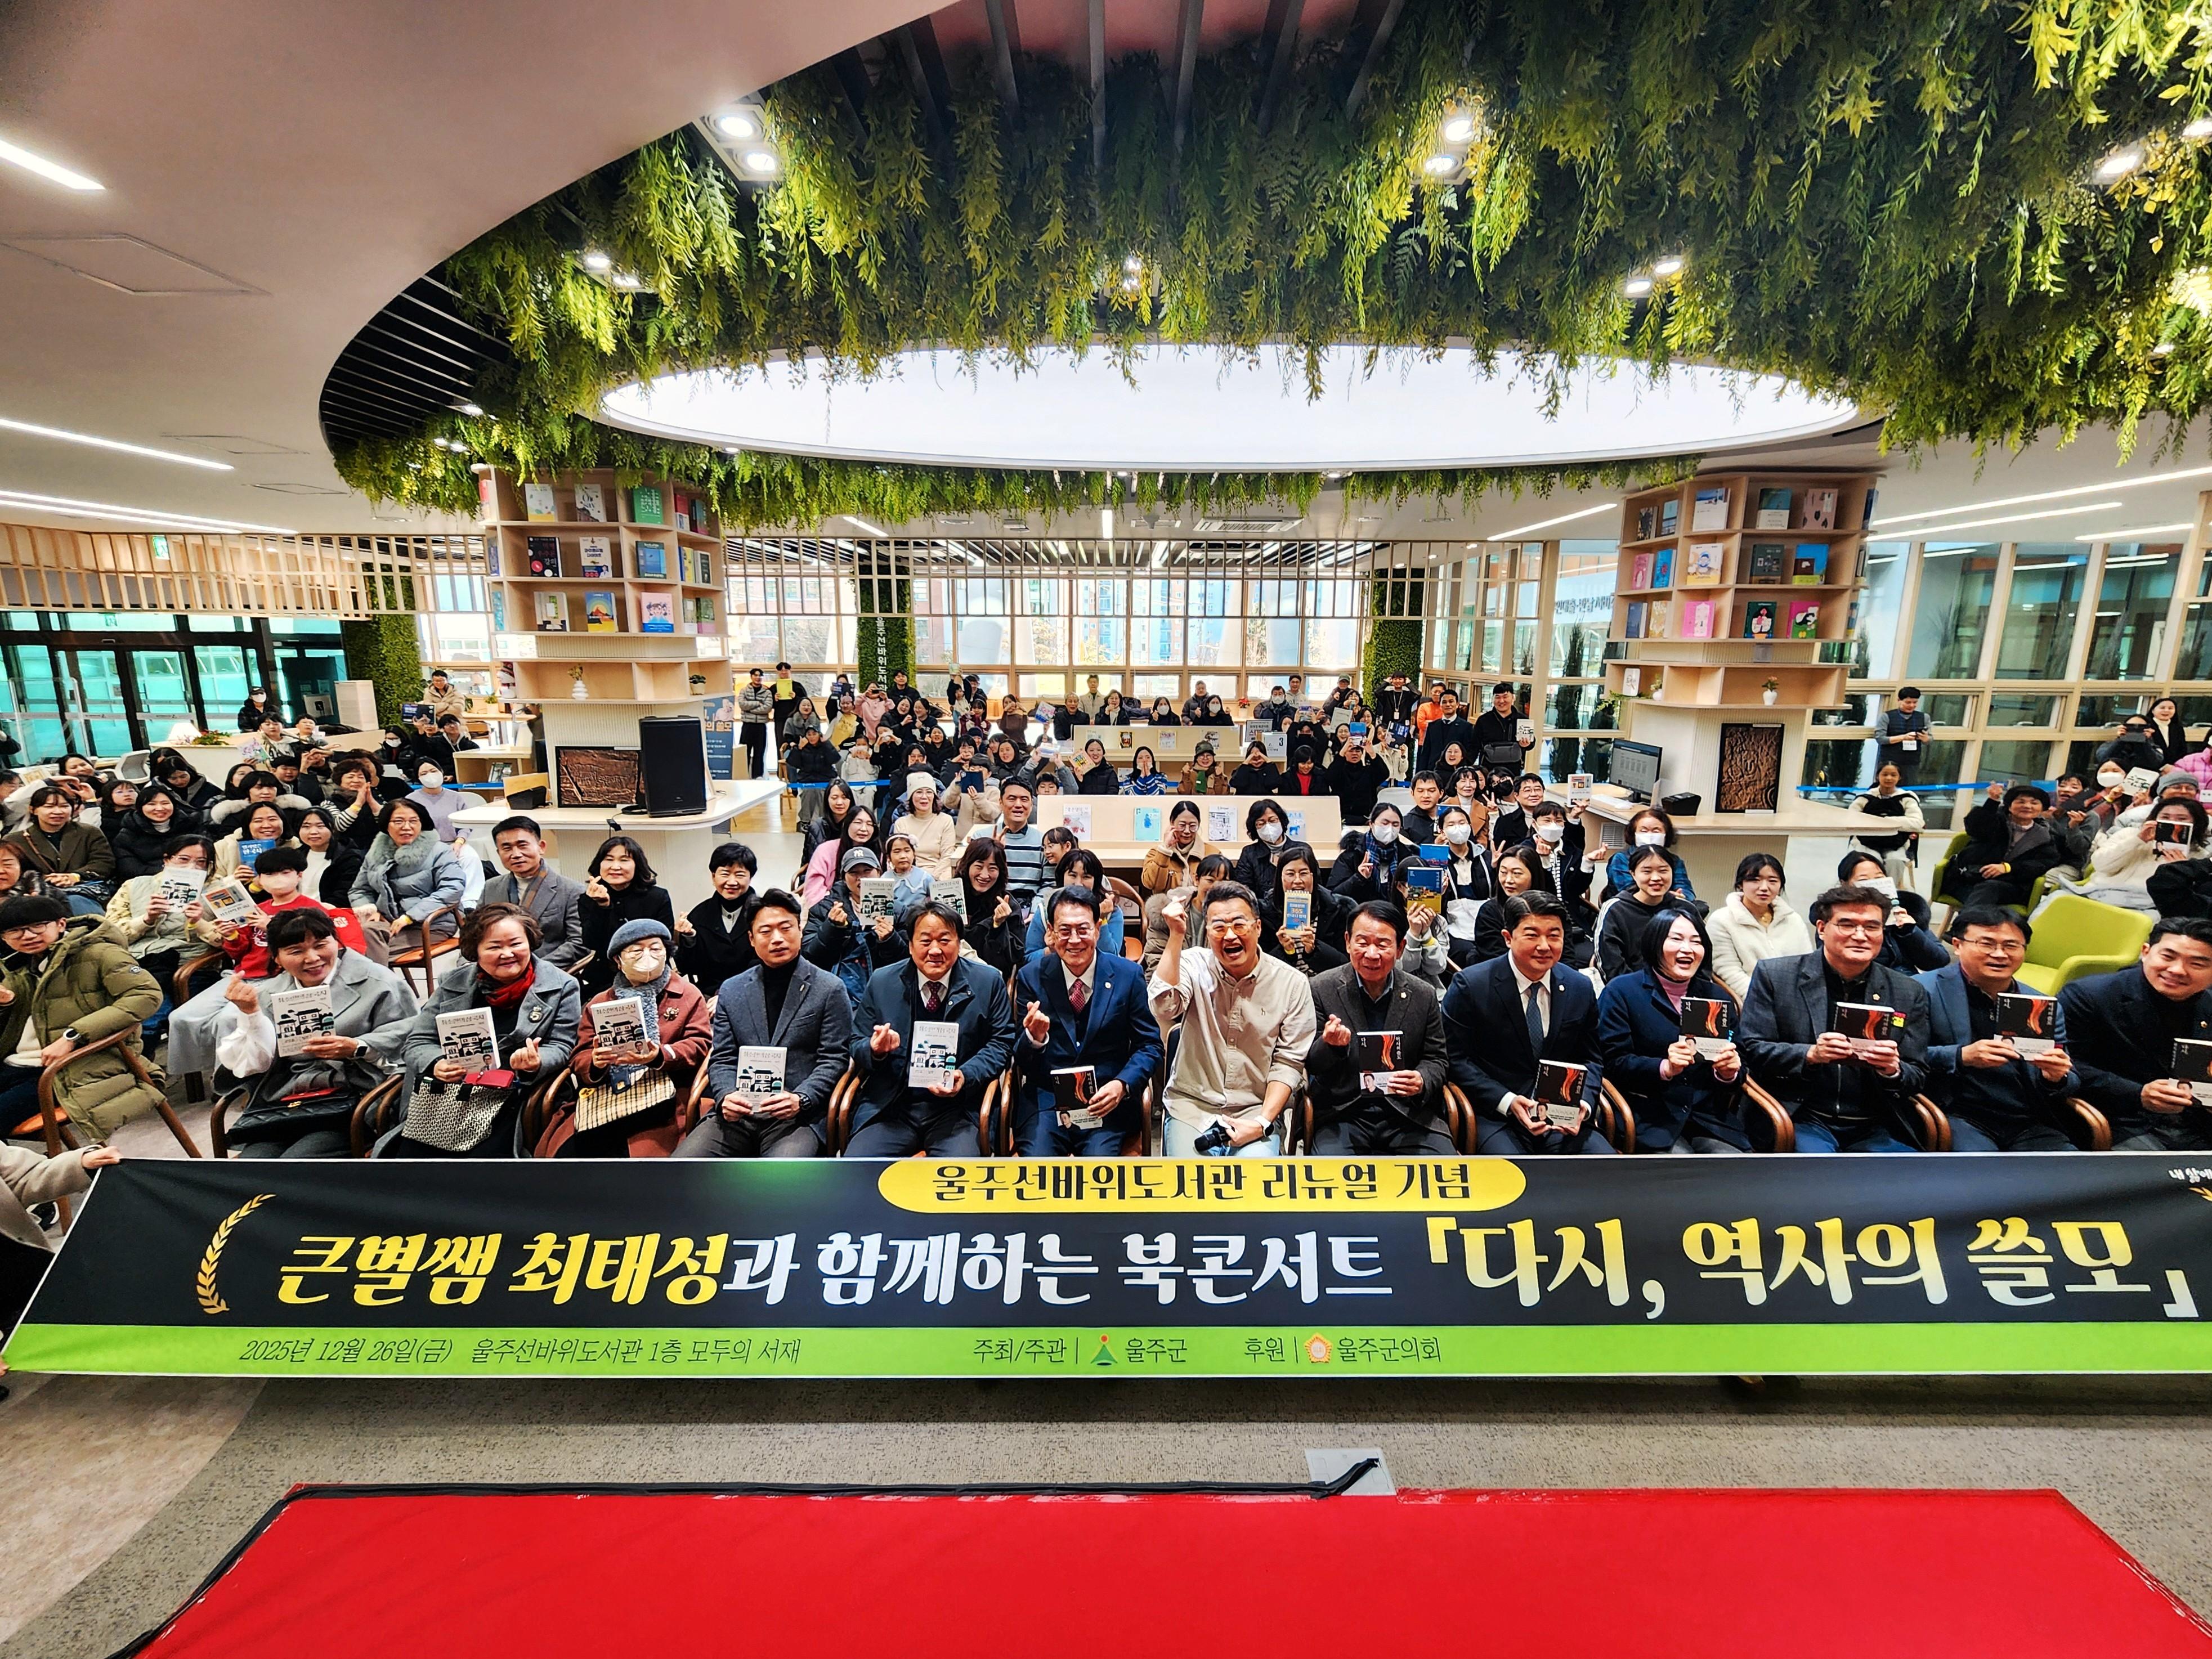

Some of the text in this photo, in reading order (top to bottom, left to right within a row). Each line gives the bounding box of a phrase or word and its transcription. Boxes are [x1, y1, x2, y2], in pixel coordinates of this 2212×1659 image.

[1555, 595, 1614, 615] 인대출·반납 서비
[717, 721, 732, 731] 쓸모
[1279, 737, 1284, 746] 3
[853, 849, 864, 858] NY
[932, 1164, 1470, 1201] 울주선바위도서관 리뉴얼 기념
[2168, 1169, 2186, 1180] 내
[278, 1217, 2200, 1319] 큰별쌤 최태성과 함께하는 북콘서트 「다시, 역사의 쓸모」
[239, 1338, 801, 1364] 2025년 12월 26일(금) 울주선바위도서관 1층 모두의 서재
[973, 1338, 1188, 1363] 주최/주관 울주군
[1244, 1337, 1441, 1363] 후원 울주군의회
